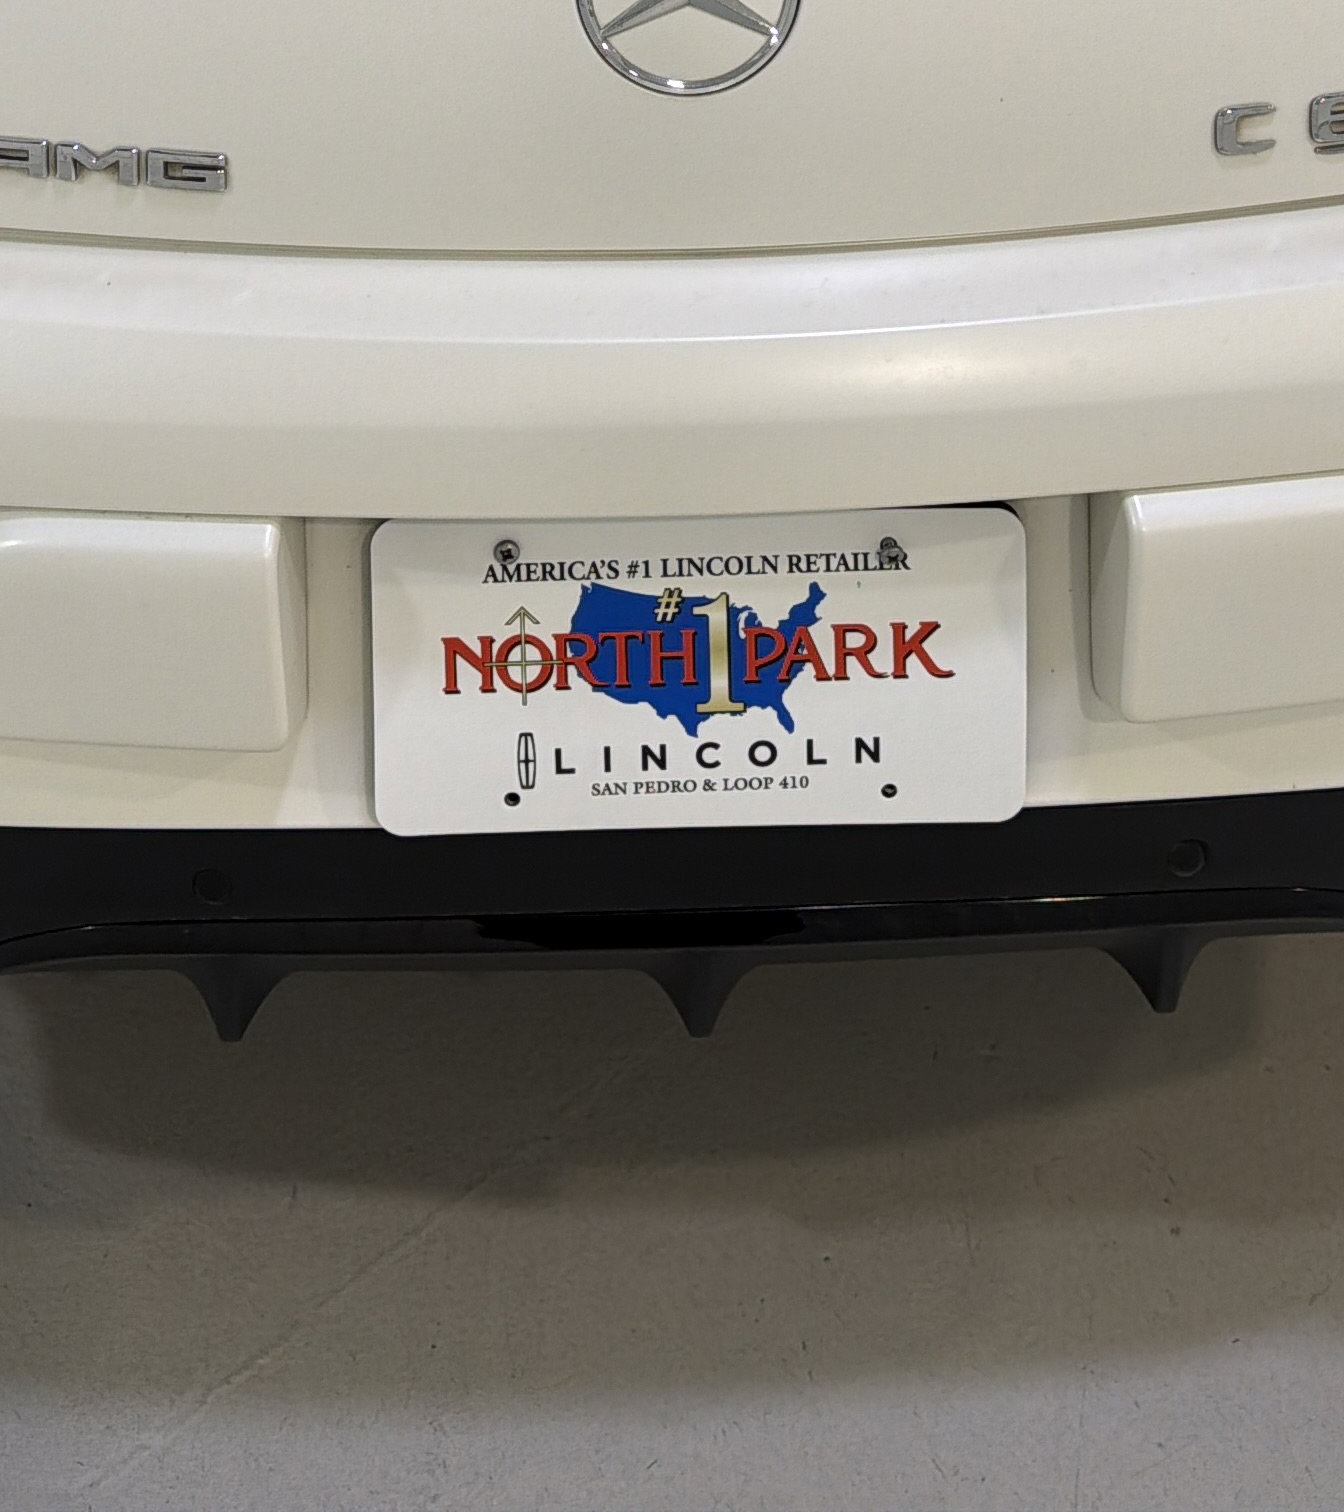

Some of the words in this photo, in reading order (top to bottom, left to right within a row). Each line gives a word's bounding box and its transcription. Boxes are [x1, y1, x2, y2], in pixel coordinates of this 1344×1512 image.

[1215, 102, 1276, 156] C
[481, 559, 620, 584] AMERICA'S
[626, 558, 653, 579] #1
[660, 554, 780, 578] LINCOLN
[440, 629, 698, 695] NORTH
[741, 620, 956, 684] PARK
[555, 736, 881, 775] LINCOLN
[591, 782, 628, 797] SAN
[633, 779, 698, 795] PEDRO
[702, 779, 717, 792] &
[722, 776, 774, 792] LOOP
[778, 775, 810, 789] 410
